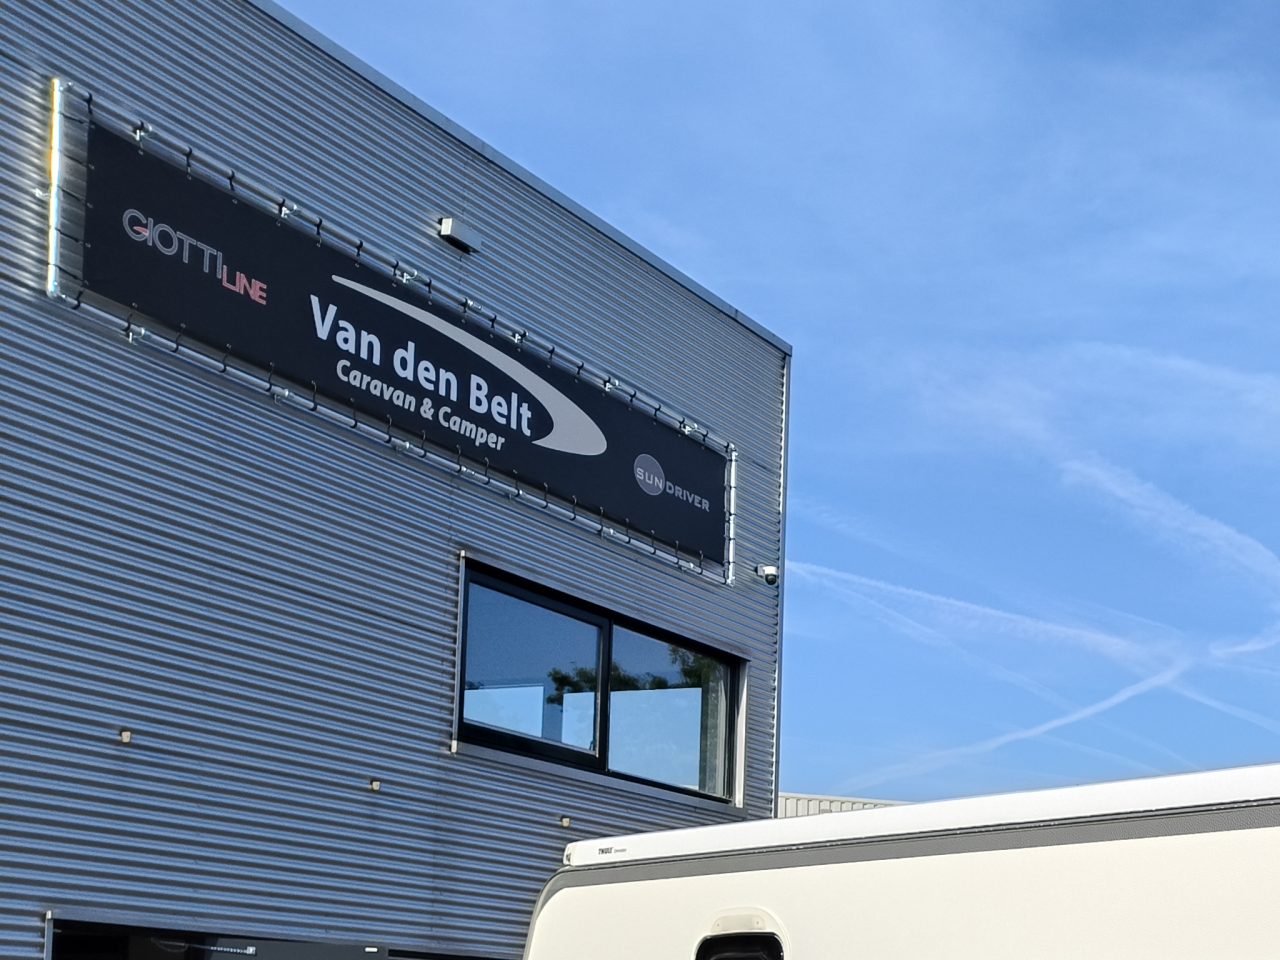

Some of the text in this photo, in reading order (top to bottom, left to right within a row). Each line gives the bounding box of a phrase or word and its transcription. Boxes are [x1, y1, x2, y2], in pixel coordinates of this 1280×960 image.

[310, 294, 532, 437] Van den Belt
[336, 359, 505, 451] Caravan & Camper
